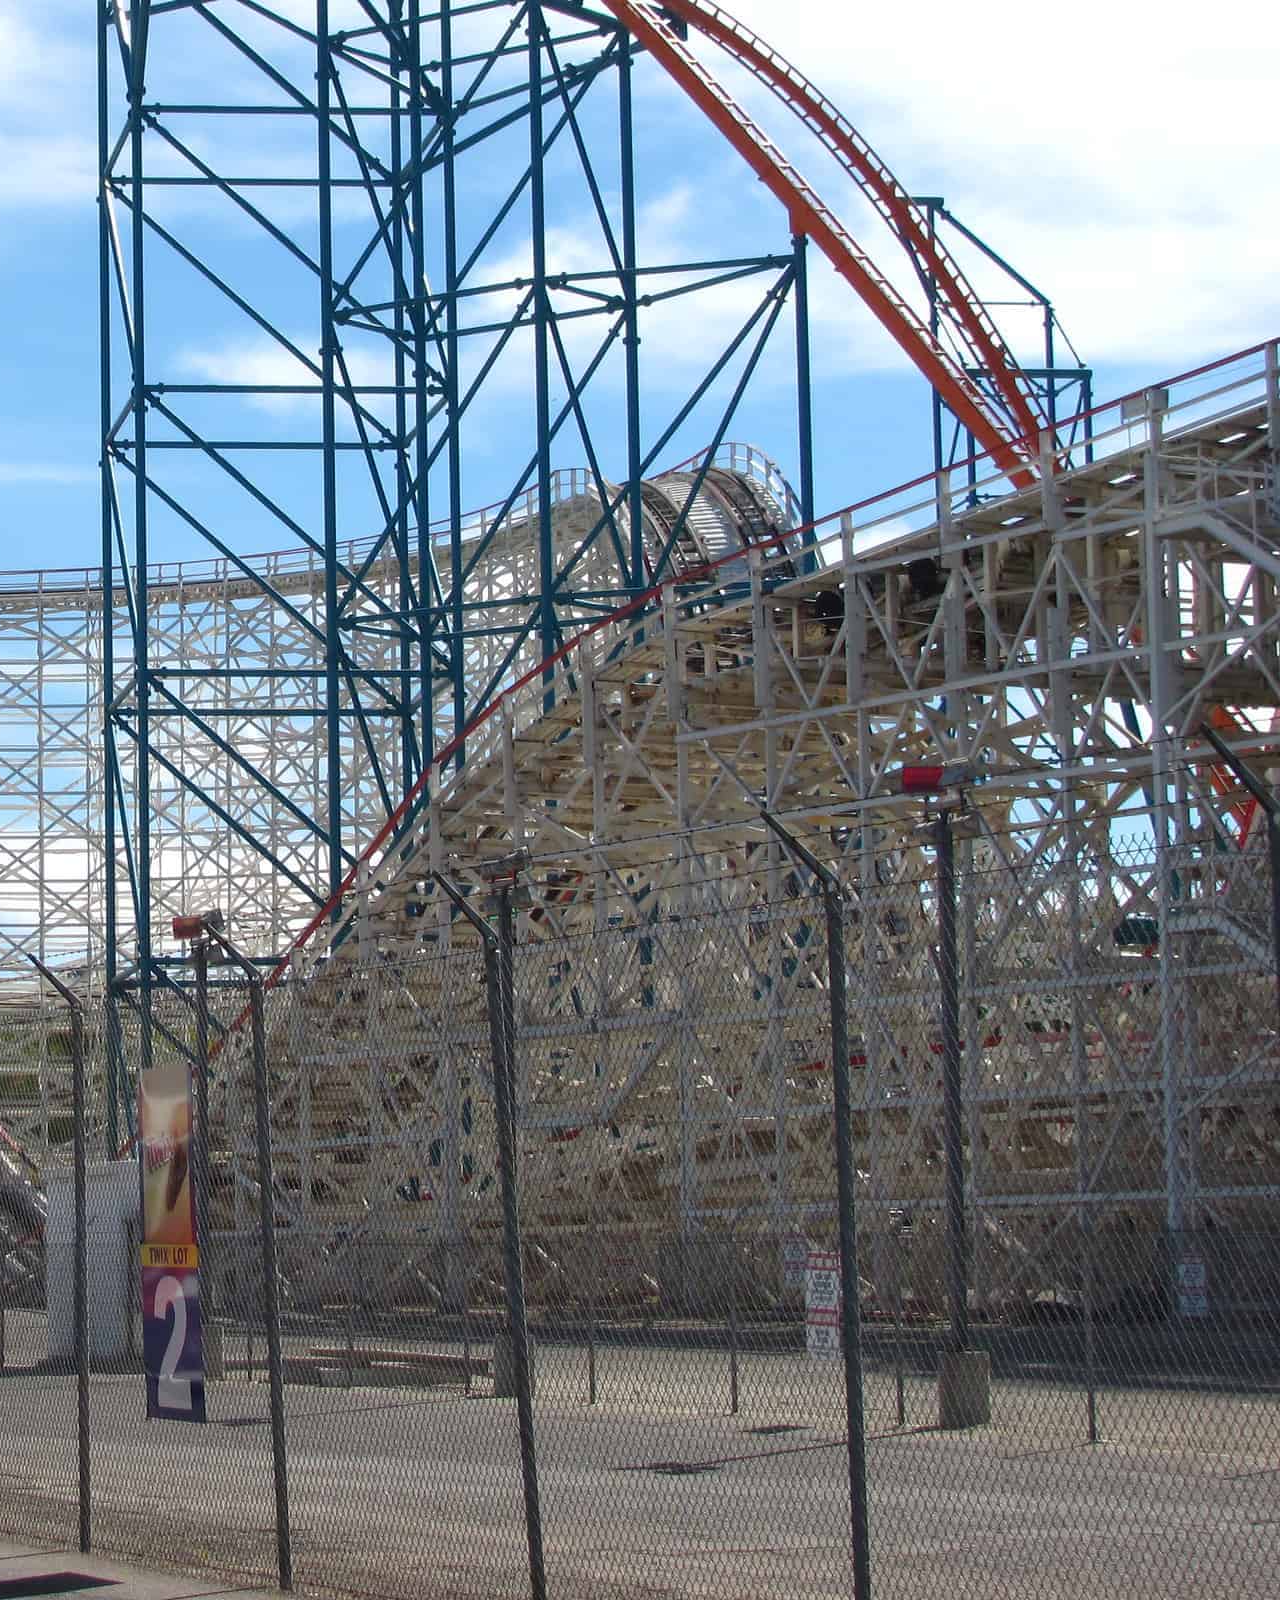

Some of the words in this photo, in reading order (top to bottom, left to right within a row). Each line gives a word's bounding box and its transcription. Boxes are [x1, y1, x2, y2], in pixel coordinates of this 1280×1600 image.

[149, 1247, 169, 1264] TWIX
[173, 1247, 188, 1264] LOT
[154, 1275, 192, 1410] 2
